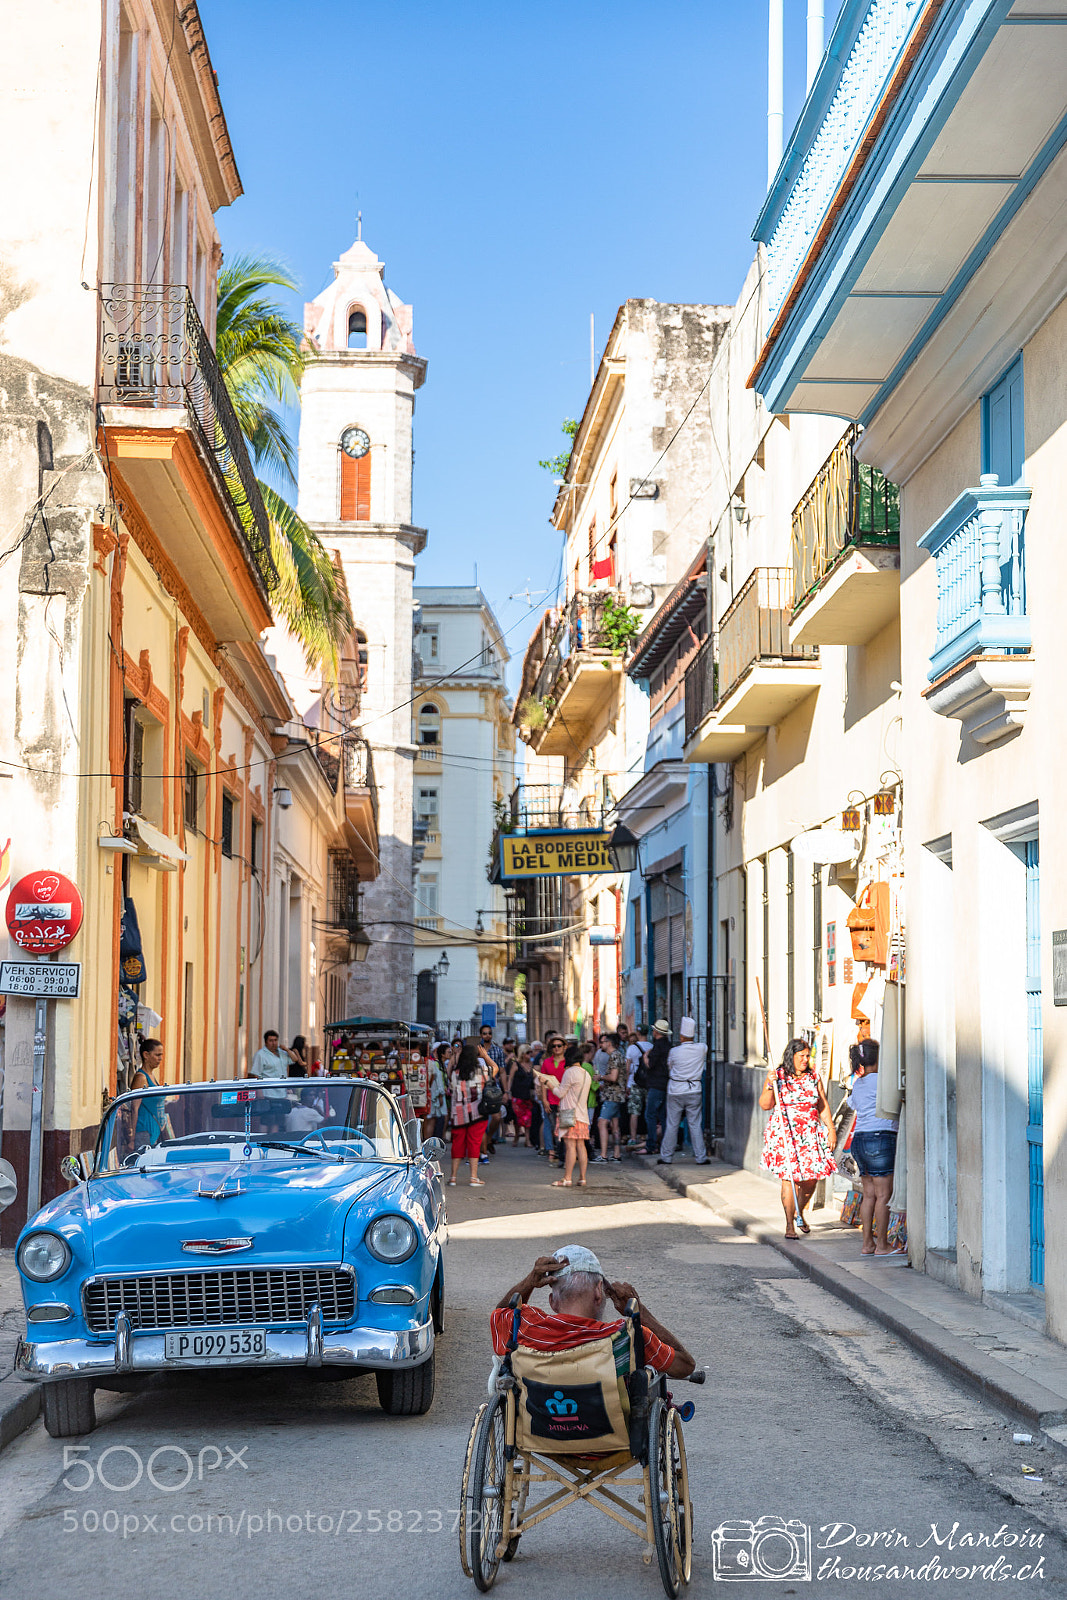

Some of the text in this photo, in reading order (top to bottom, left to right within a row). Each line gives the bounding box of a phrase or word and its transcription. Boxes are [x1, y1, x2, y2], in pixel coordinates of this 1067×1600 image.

[512, 840, 608, 855] LA BODEGUIT
[512, 852, 613, 869] DEL MEDI
[9, 975, 36, 984] 06:00
[8, 983, 35, 991] 18:00
[43, 984, 69, 993] 21:00
